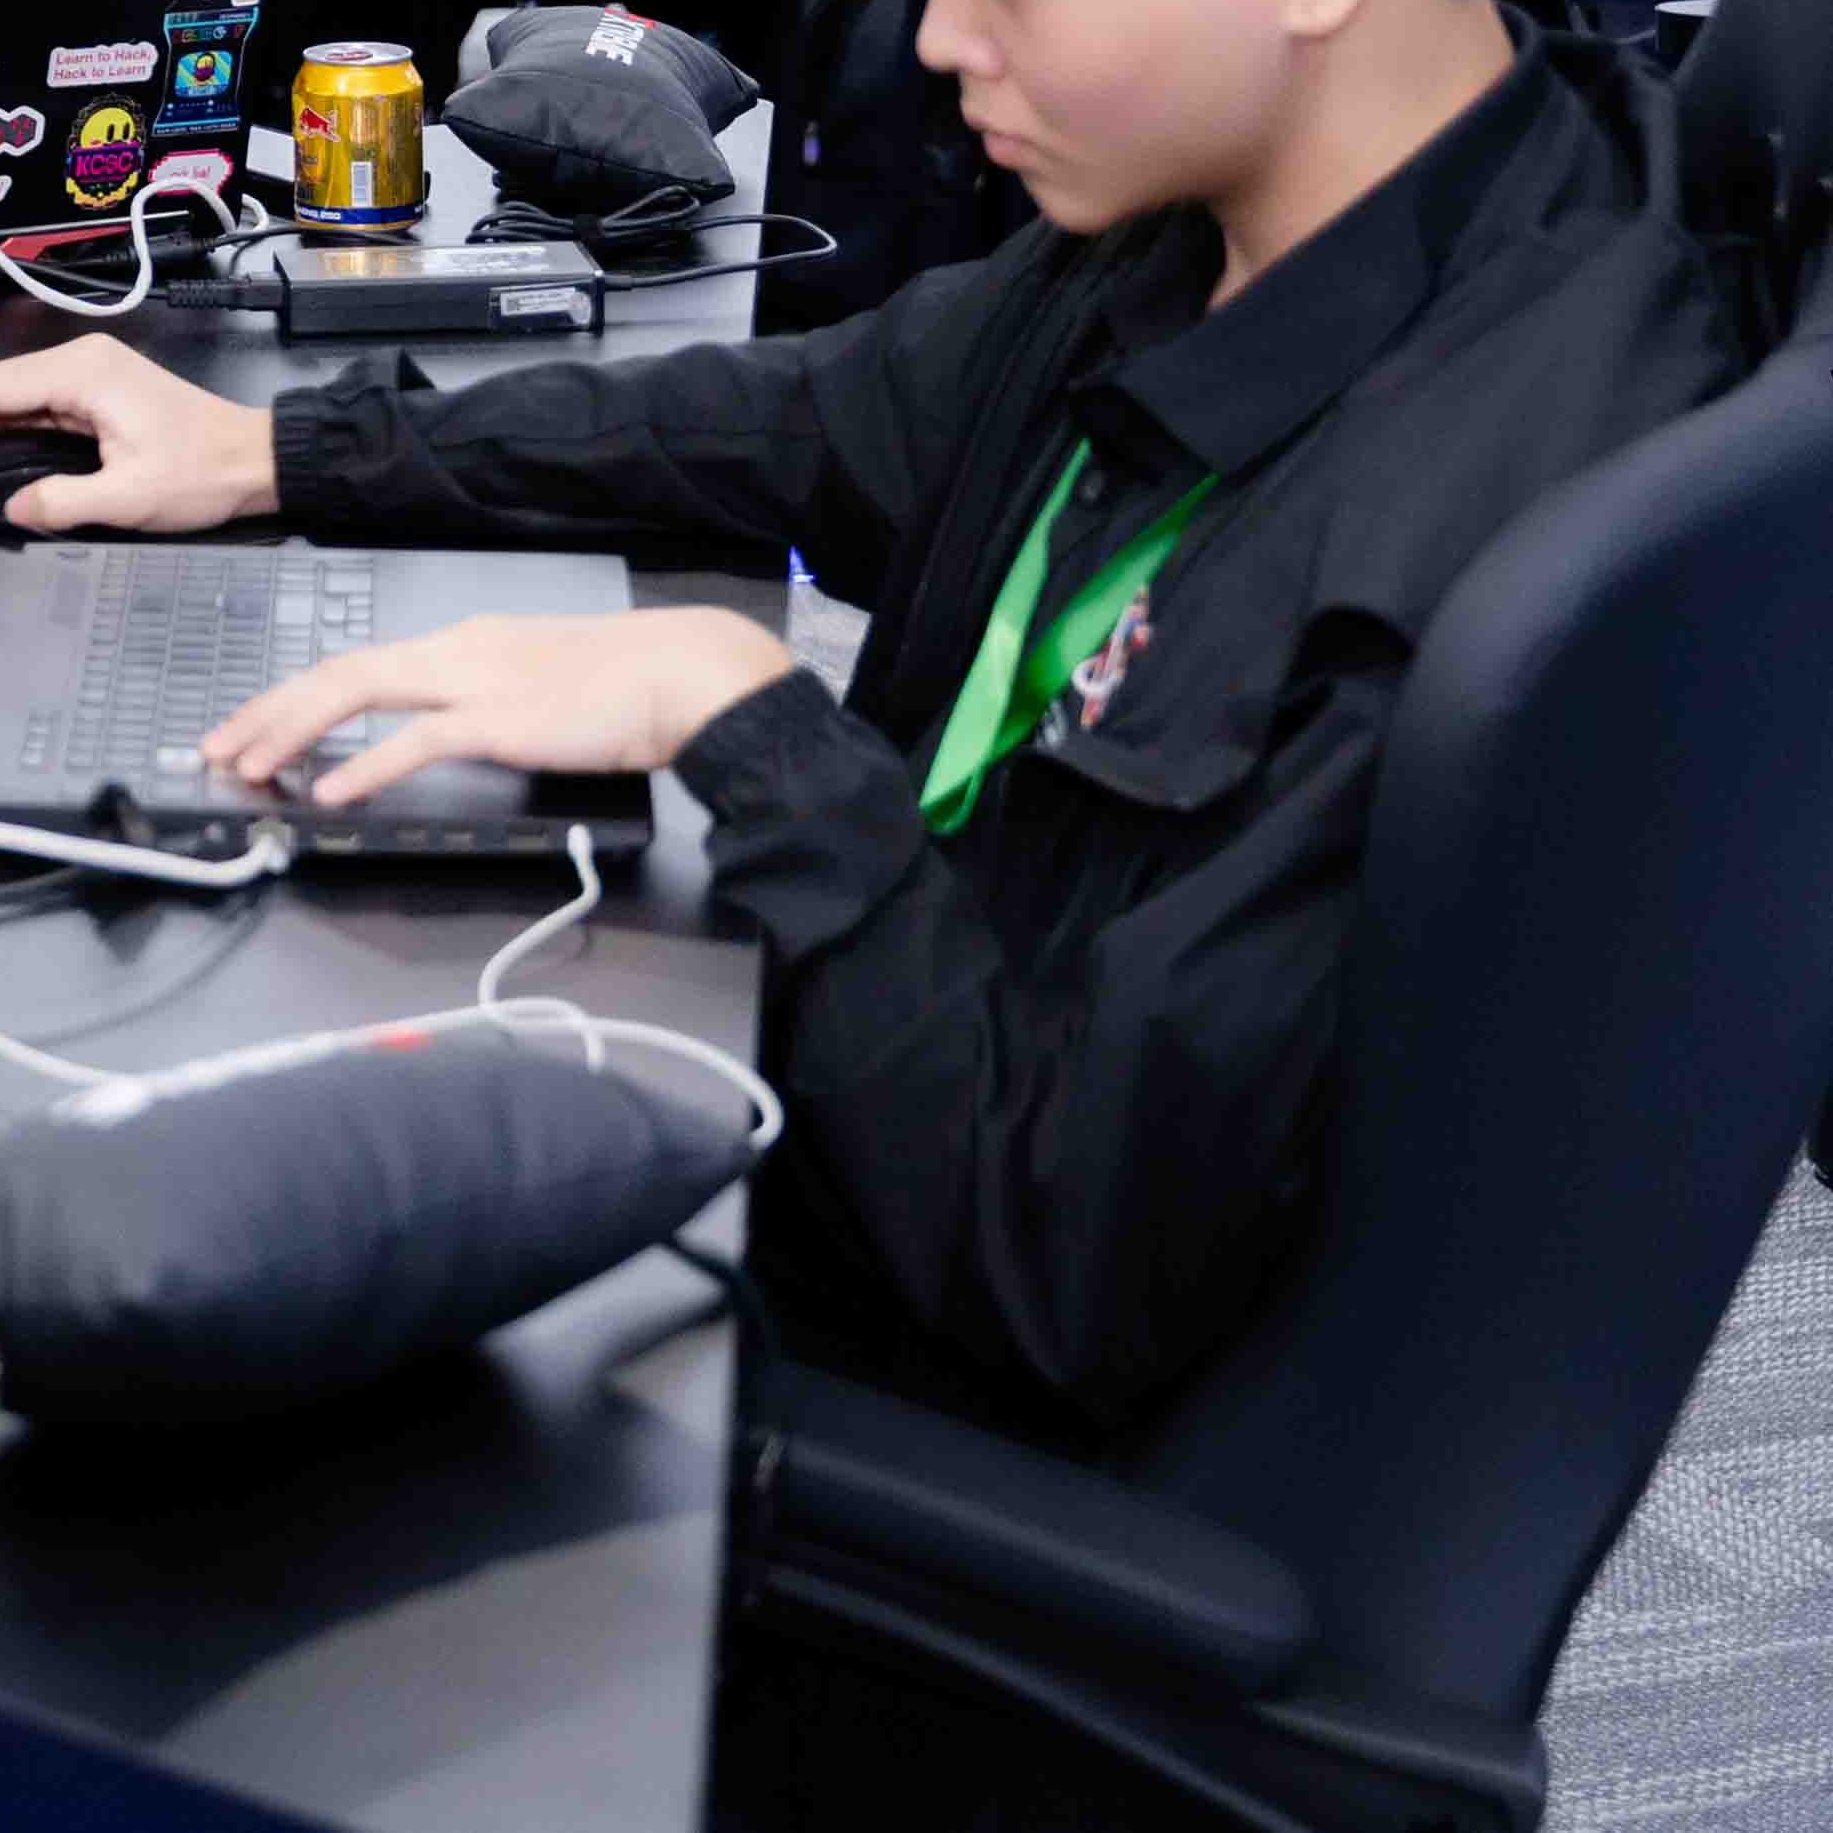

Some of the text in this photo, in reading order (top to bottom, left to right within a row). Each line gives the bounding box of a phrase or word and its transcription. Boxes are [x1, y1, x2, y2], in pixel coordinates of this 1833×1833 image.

[56, 51, 94, 65] Learn
[97, 51, 111, 62] to
[53, 64, 146, 80] Hack to Learn
[75, 152, 134, 176] KCSC
